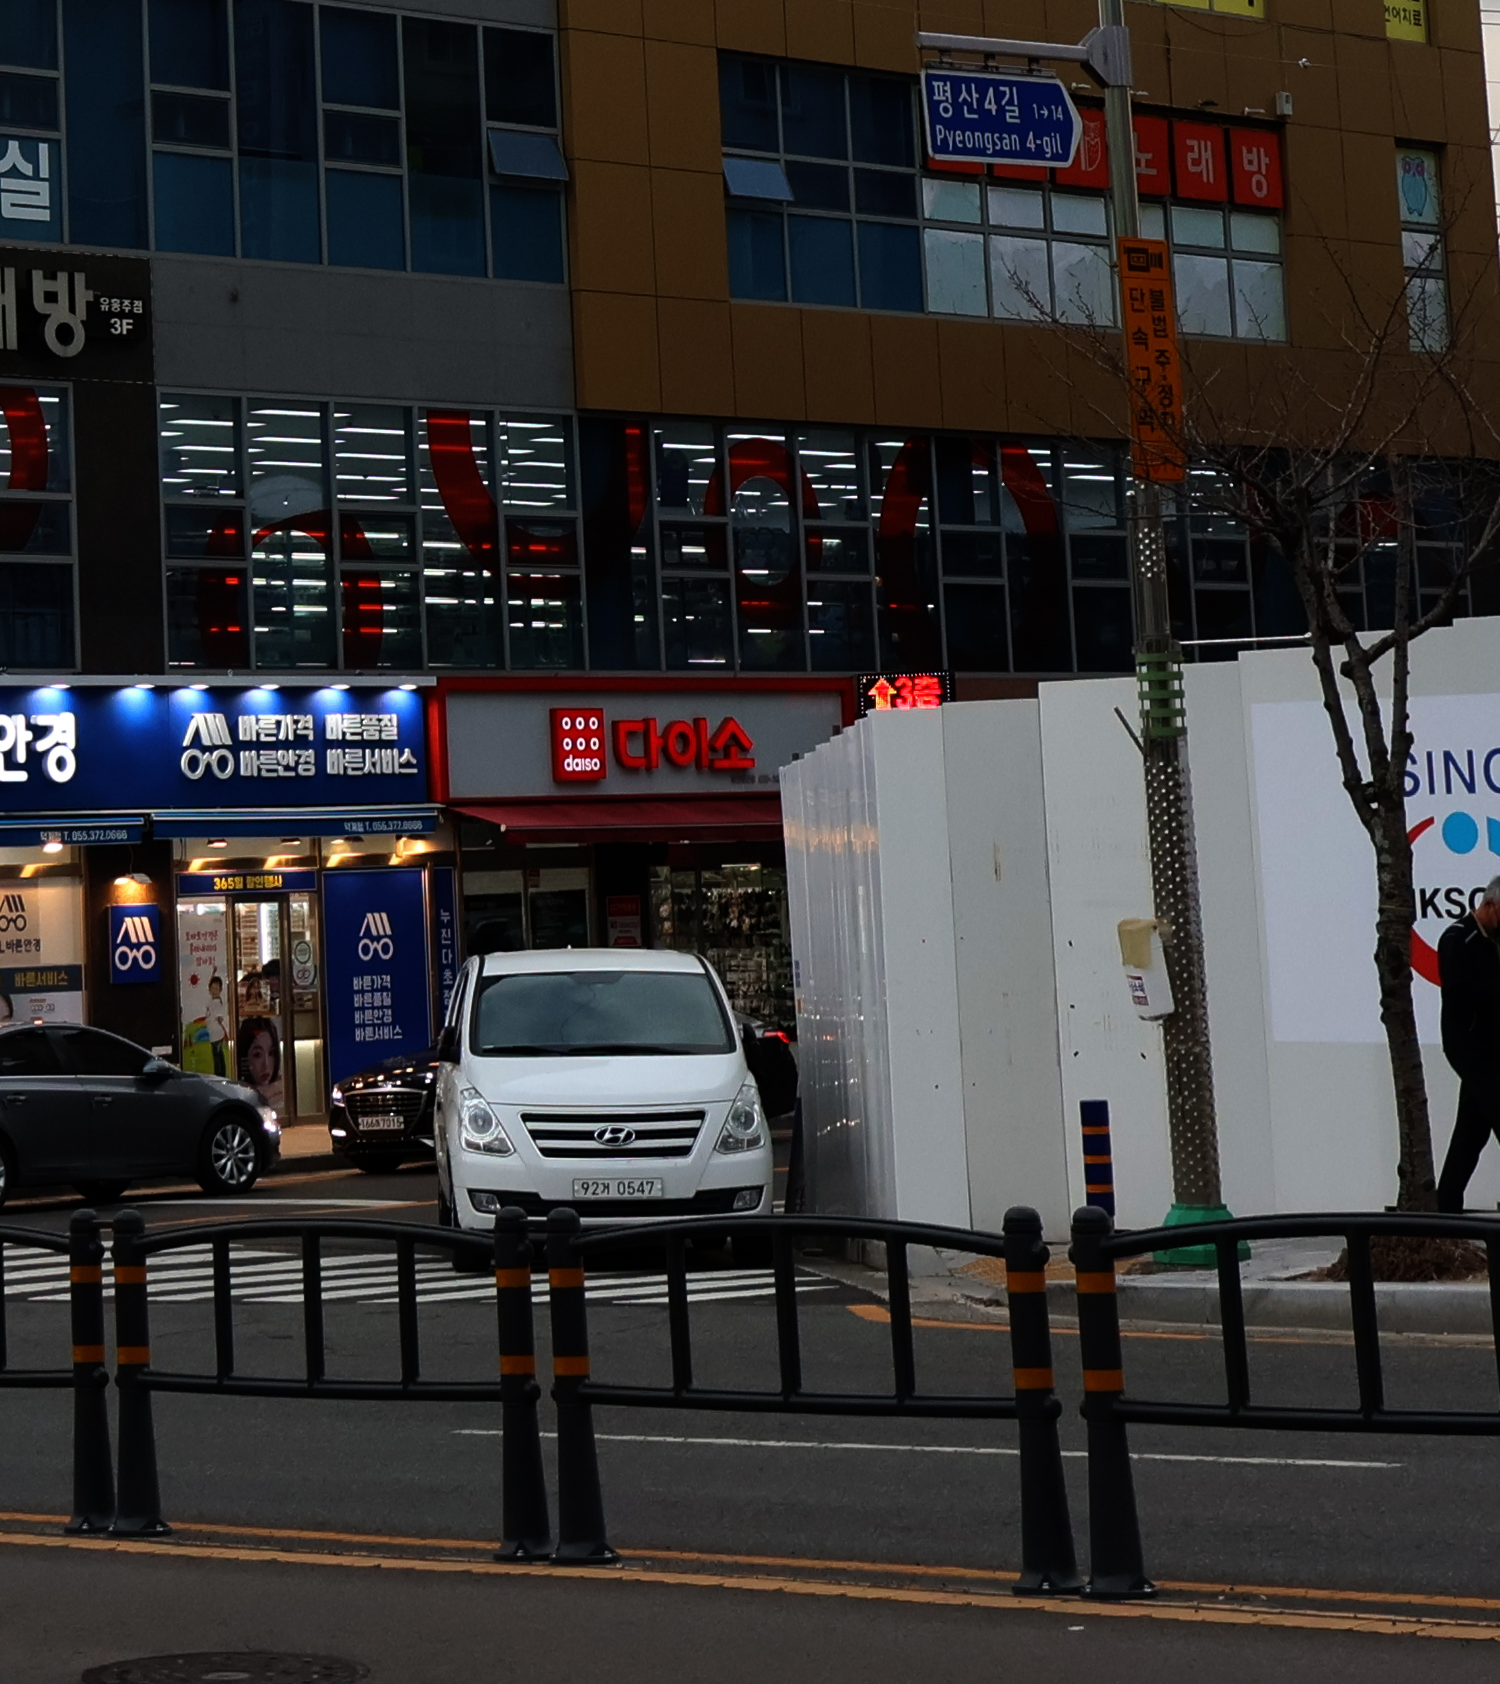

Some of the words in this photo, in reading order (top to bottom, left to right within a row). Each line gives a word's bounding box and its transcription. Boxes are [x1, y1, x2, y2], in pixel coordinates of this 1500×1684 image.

[932, 81, 1020, 123] 평산4길
[936, 125, 1020, 154] Pyeongsan
[1026, 129, 1063, 158] 4-gil
[109, 317, 134, 335] 3F
[238, 715, 314, 743] 바른가격
[325, 714, 399, 741] 바른품질
[612, 717, 756, 771] 다이소
[239, 748, 316, 777] 바른안경
[327, 747, 418, 776] 바른서비스
[564, 755, 600, 771] daiso
[14, 971, 68, 987] 바른서비스
[353, 975, 391, 990] 바른가격
[354, 1009, 392, 1024] 바른안경
[355, 1025, 402, 1042] 바른서비스
[617, 1181, 655, 1196] 0547
